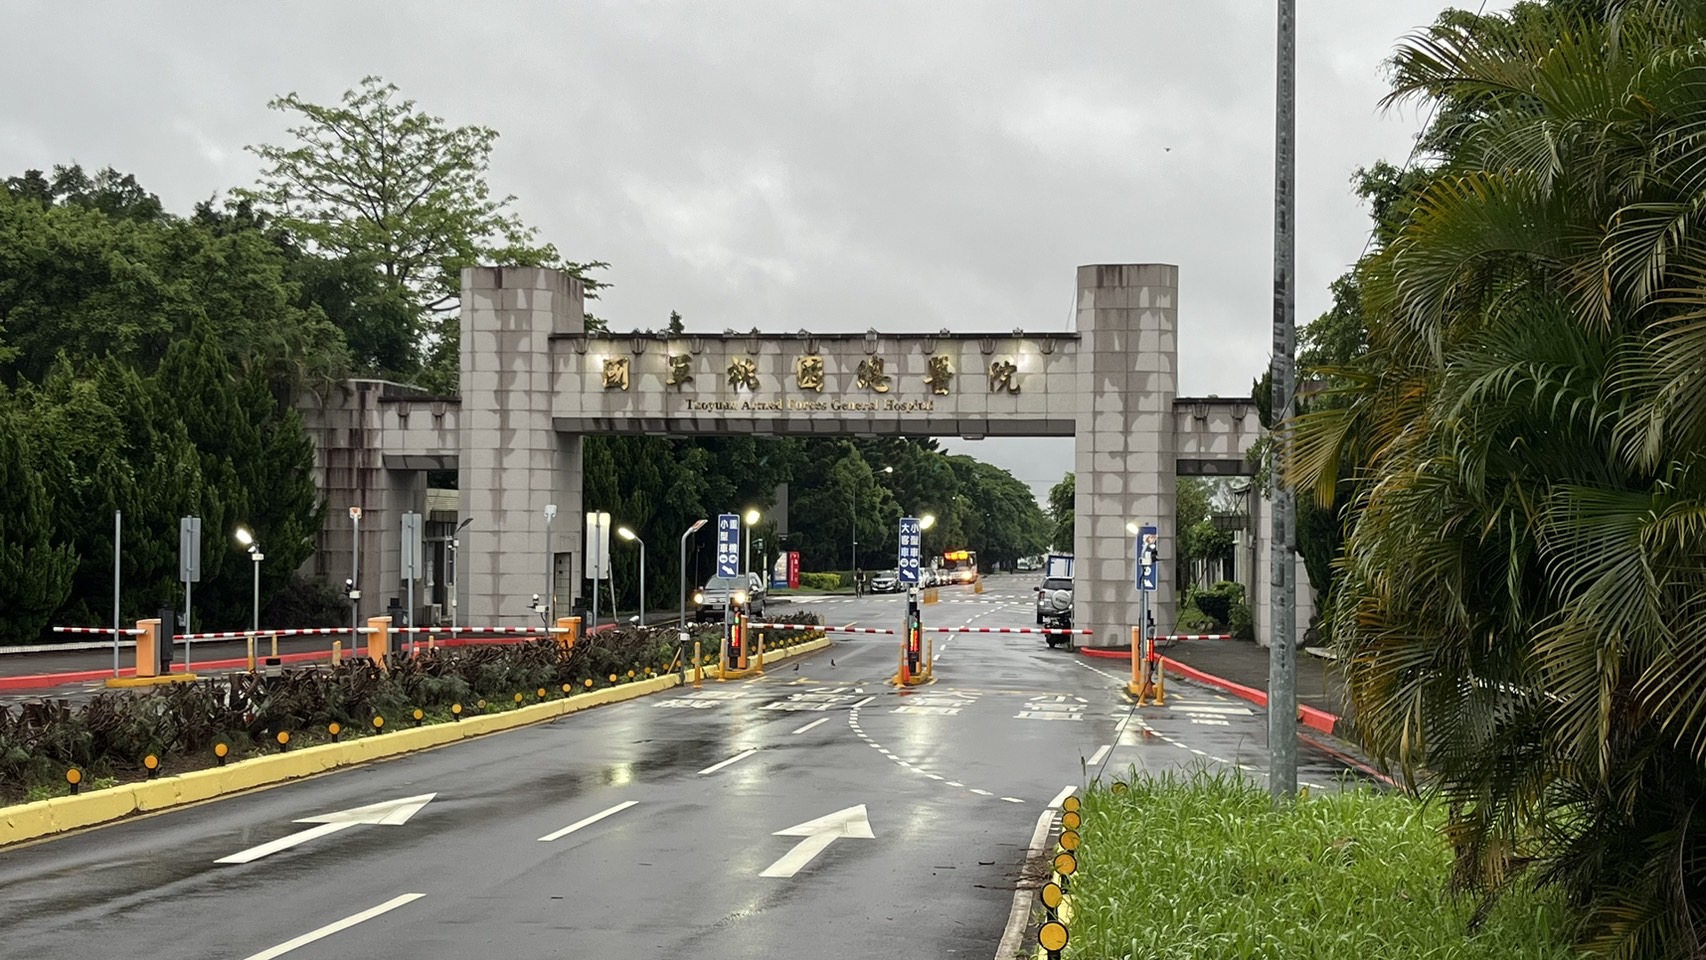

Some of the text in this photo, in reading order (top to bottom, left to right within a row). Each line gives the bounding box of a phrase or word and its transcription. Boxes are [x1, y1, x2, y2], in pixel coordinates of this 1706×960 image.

[602, 354, 1021, 395] 國軍桃園總醫院
[686, 398, 934, 414] Taoyuan Armed Forces General Hospital
